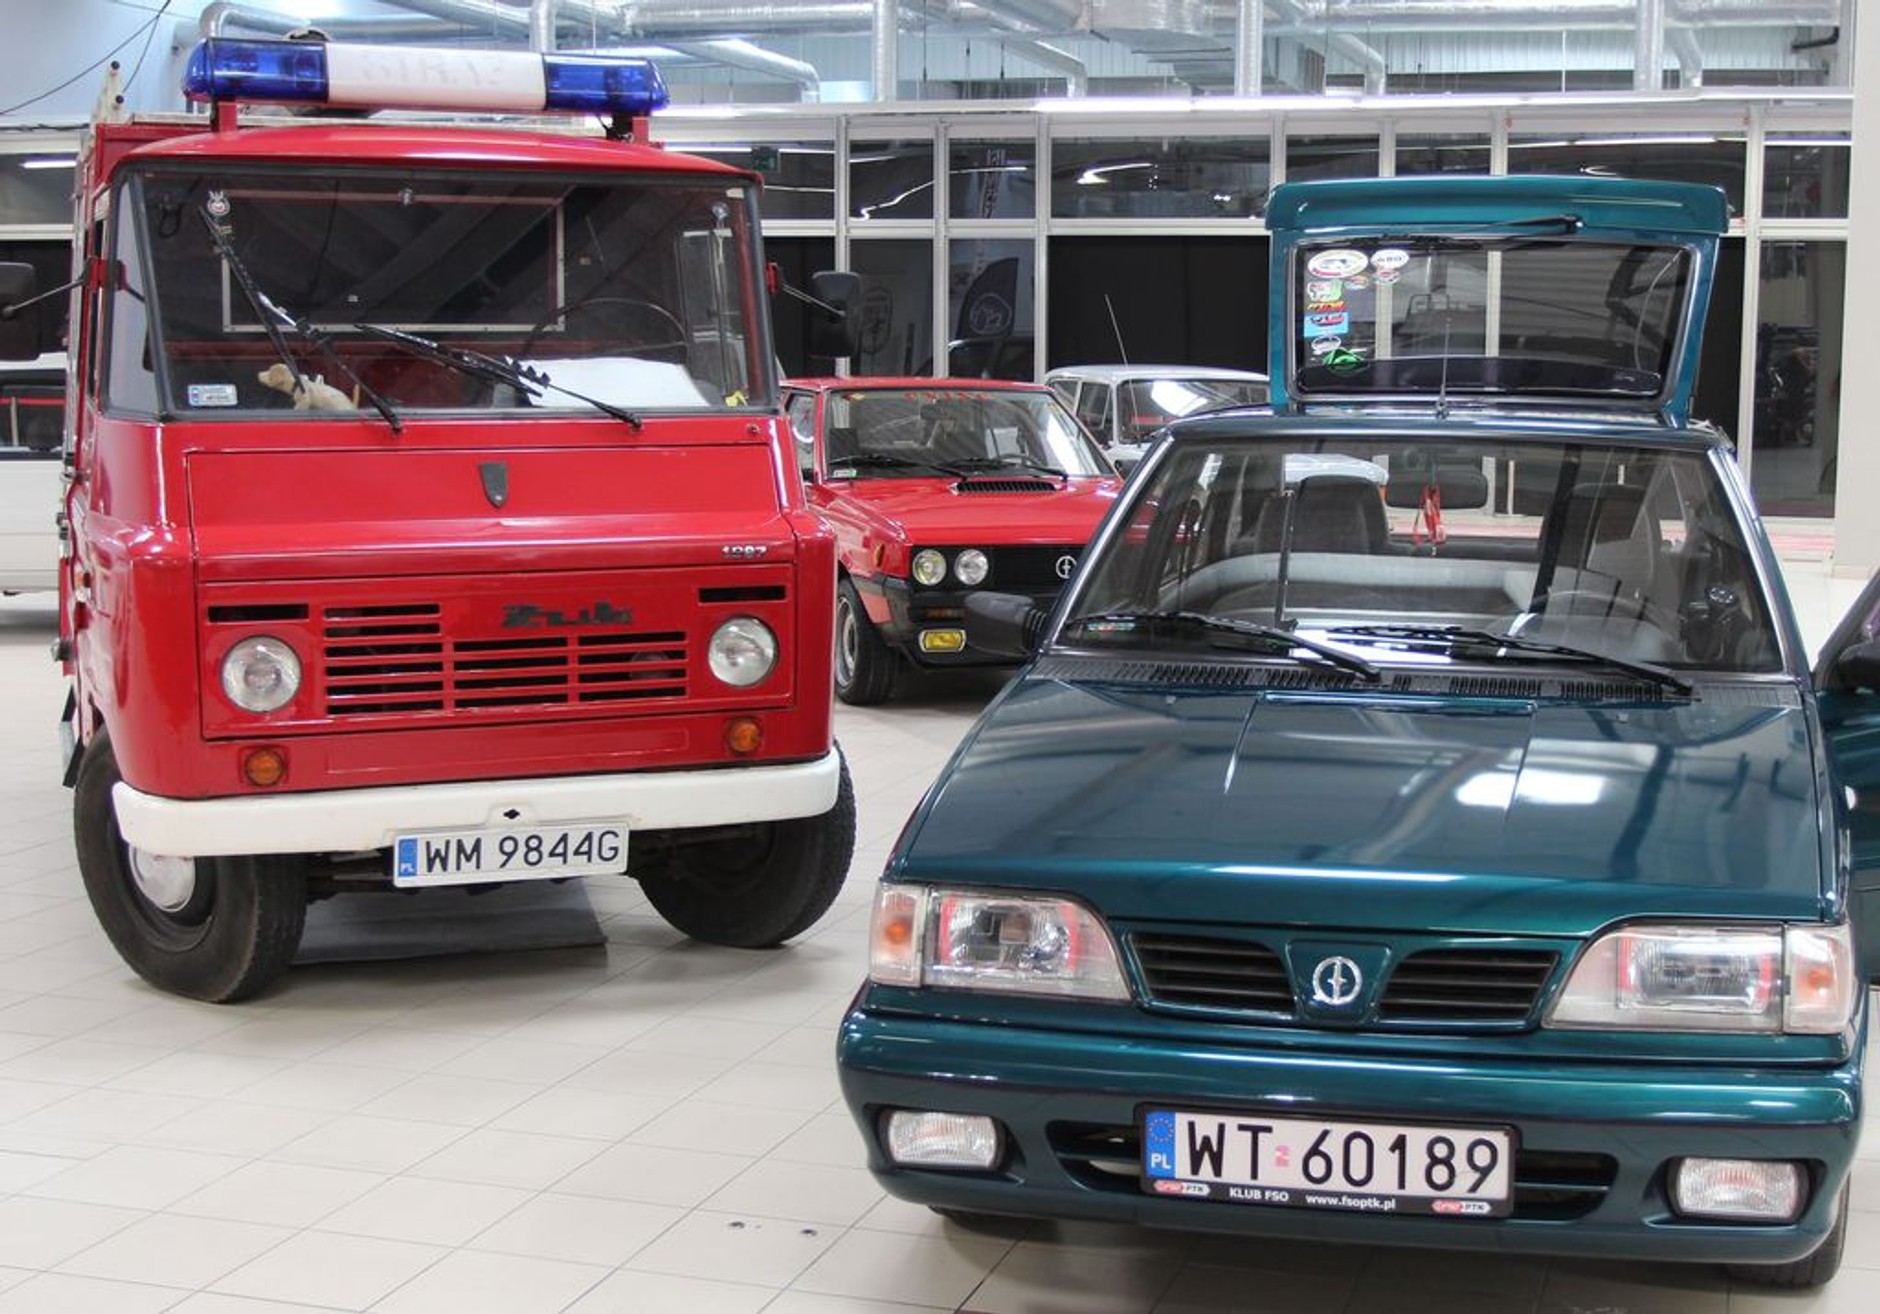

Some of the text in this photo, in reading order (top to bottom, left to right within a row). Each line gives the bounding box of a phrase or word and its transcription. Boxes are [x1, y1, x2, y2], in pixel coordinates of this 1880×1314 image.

[425, 830, 619, 873] WM 9844G
[1151, 1152, 1172, 1169] PL
[1187, 1120, 1498, 1193] WT 60189
[1229, 1186, 1289, 1202] KLUB FSO
[1305, 1193, 1396, 1211] www.fsoptk.pl
